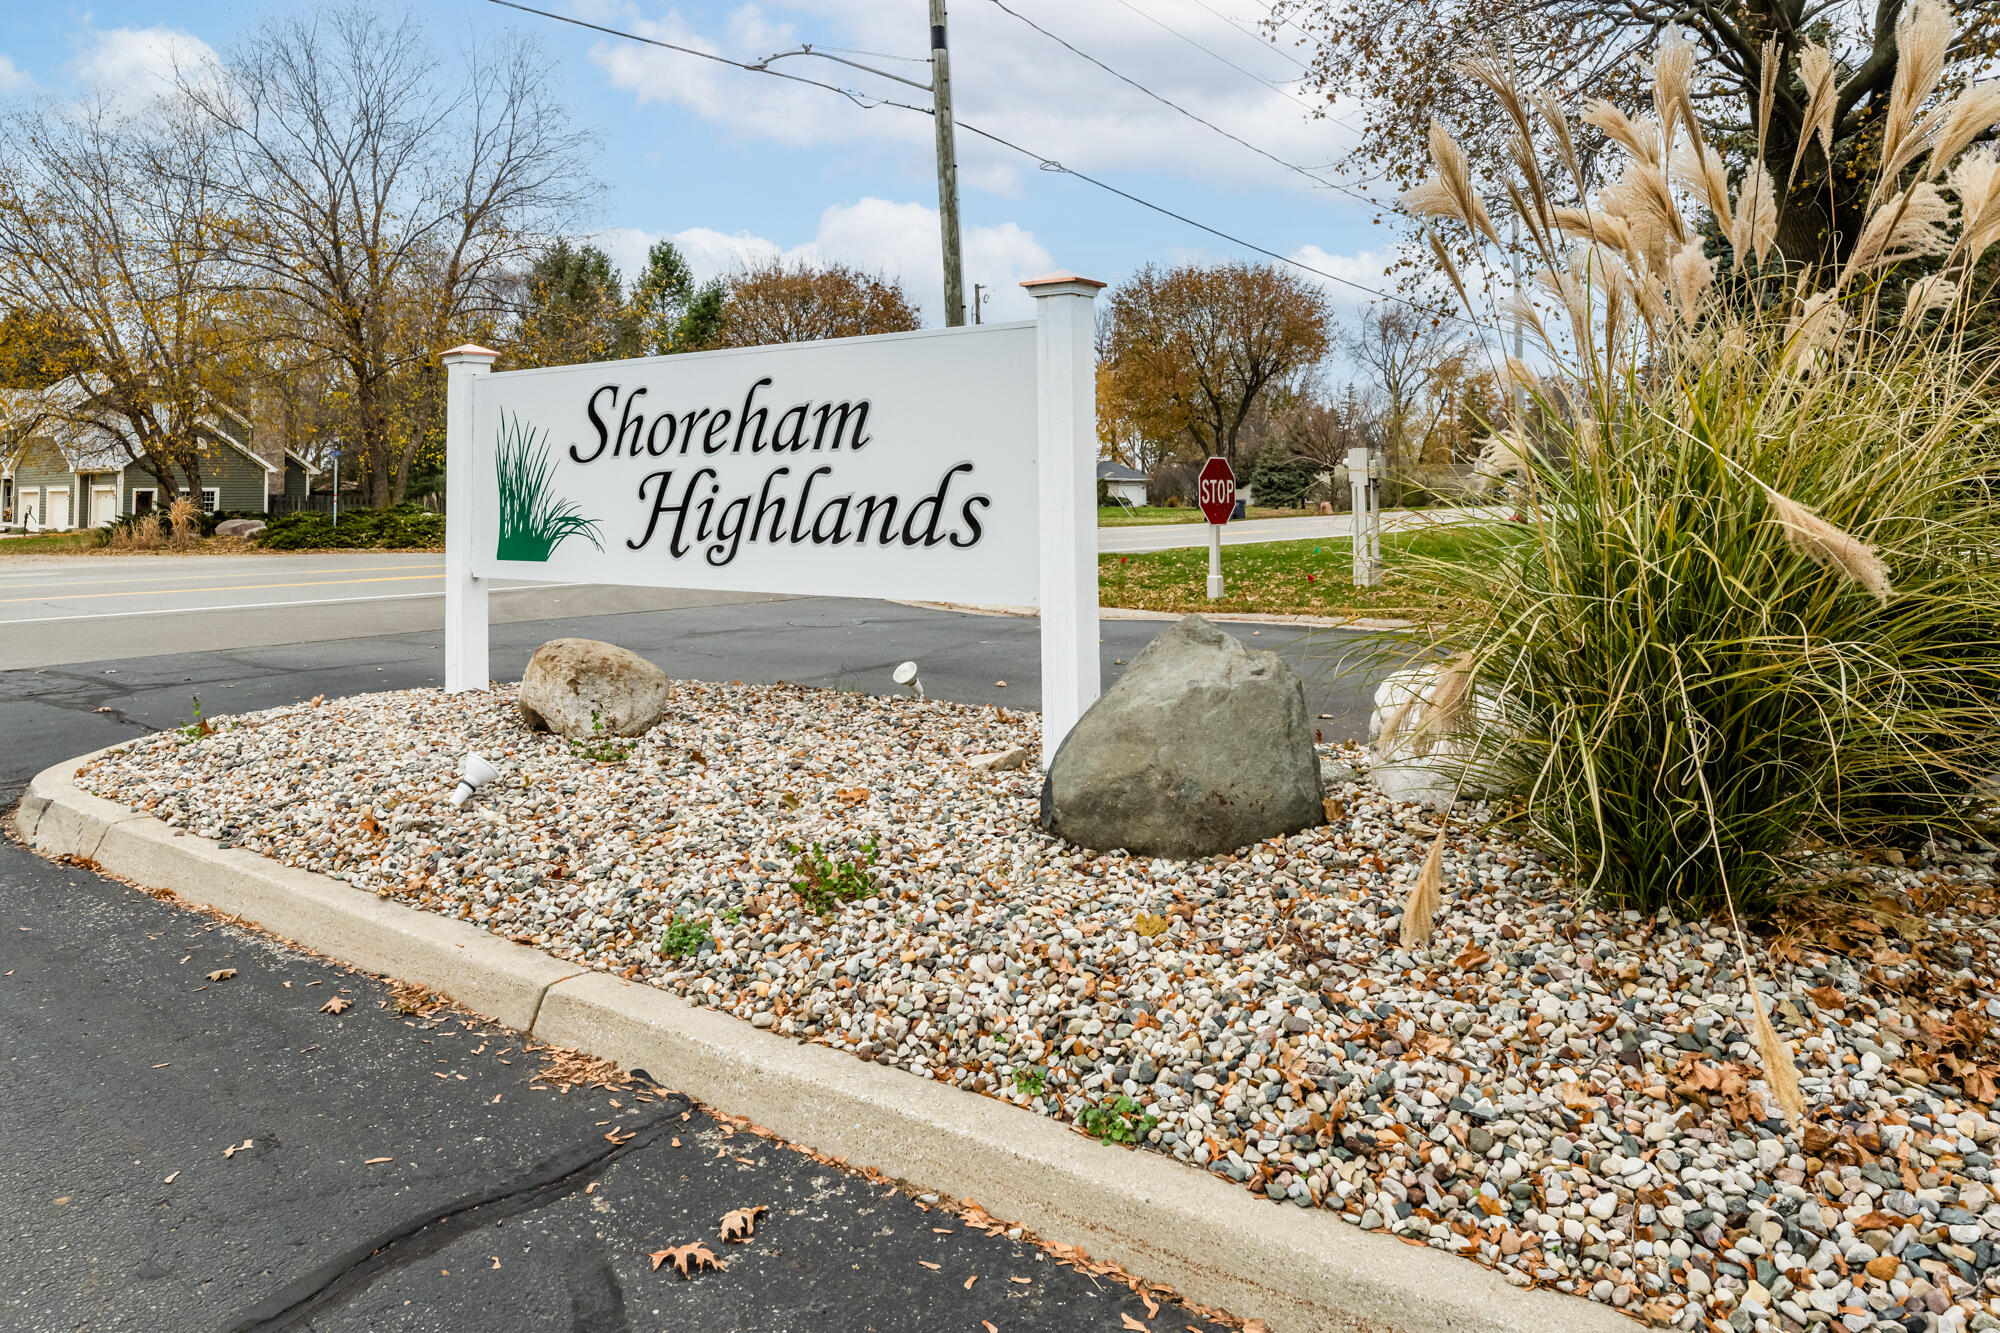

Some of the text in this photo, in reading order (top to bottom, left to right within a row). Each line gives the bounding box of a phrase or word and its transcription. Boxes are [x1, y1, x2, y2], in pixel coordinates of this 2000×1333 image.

[569, 376, 872, 464] Shoreham
[626, 461, 991, 567] Highlands
[1202, 479, 1234, 504] STOP
